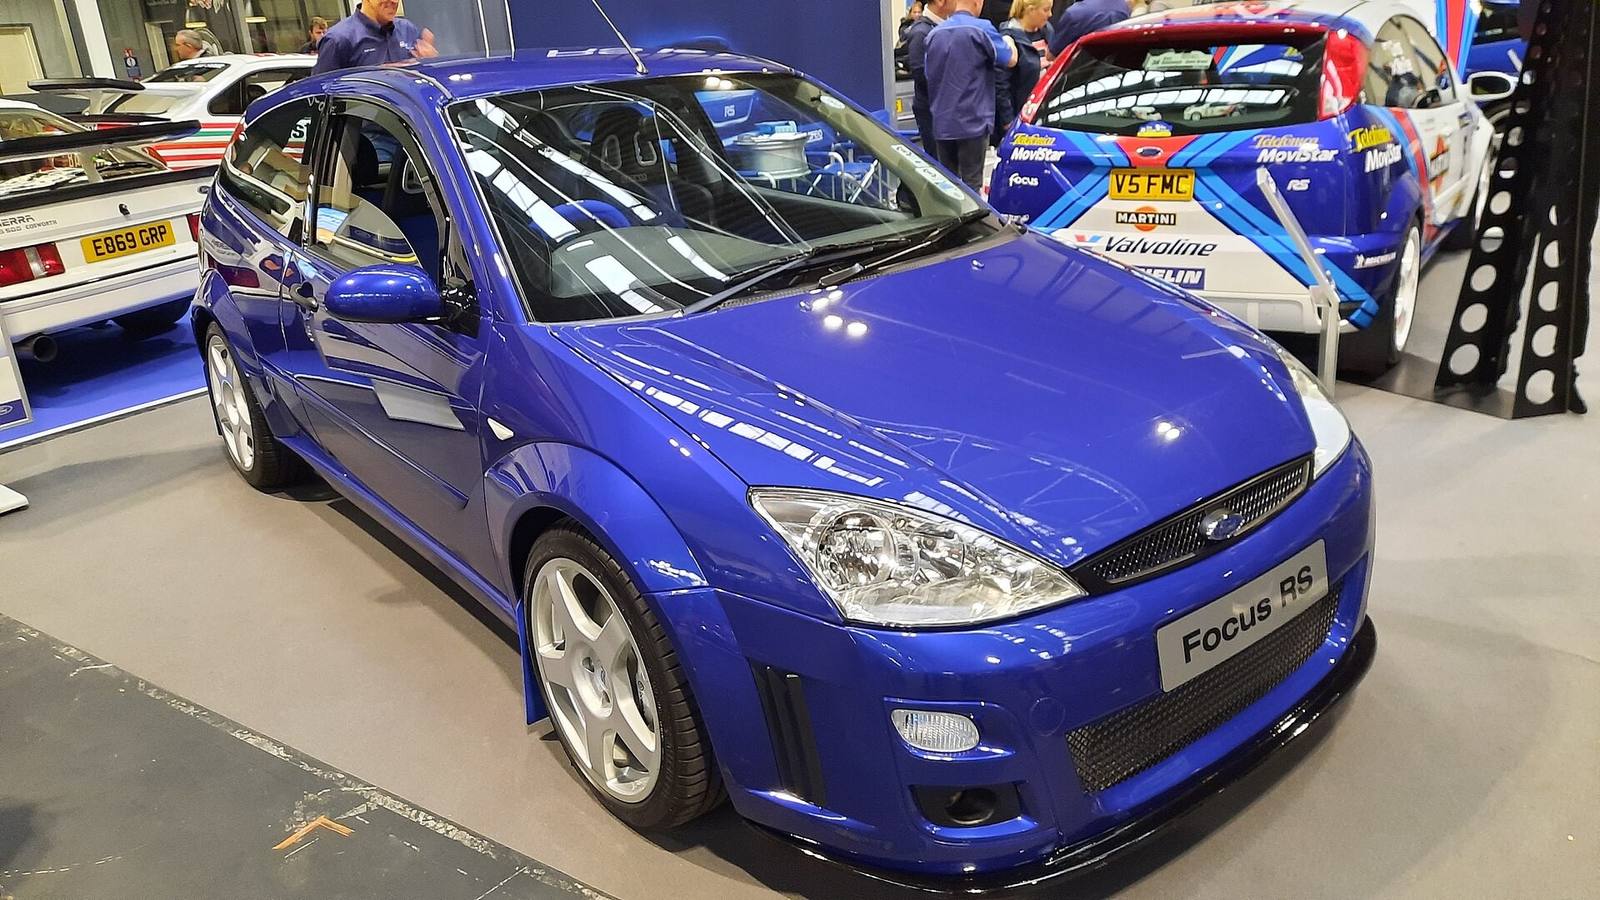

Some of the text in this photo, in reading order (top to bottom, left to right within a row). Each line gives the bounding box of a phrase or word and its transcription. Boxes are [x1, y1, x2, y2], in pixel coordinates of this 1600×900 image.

[1257, 148, 1339, 163] MoviStar
[1115, 174, 1190, 196] V5 FMC
[1286, 178, 1311, 191] RS
[1117, 211, 1175, 226] MARTINI
[92, 225, 168, 256] E869 GRP
[1105, 236, 1218, 257] Valvoline
[1182, 565, 1313, 664] Focus RS
